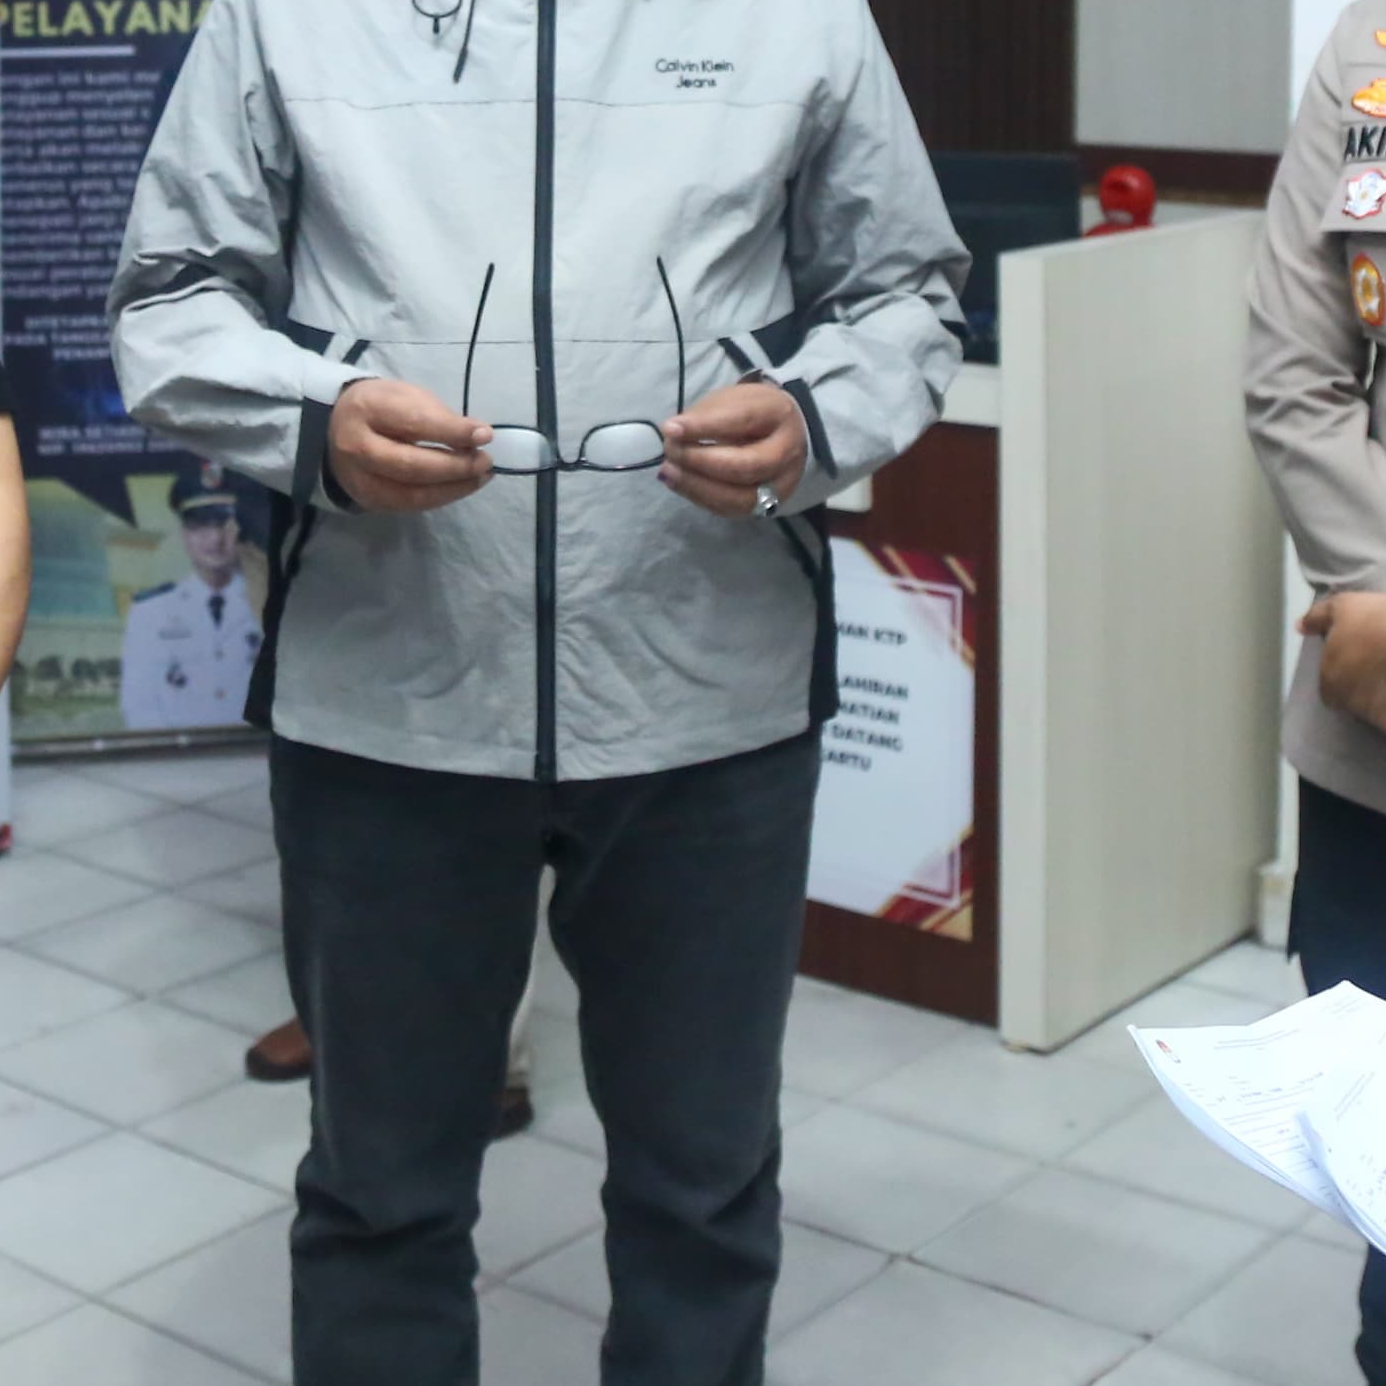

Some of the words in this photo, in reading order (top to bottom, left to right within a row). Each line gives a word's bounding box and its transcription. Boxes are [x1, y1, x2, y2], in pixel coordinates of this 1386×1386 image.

[655, 58, 699, 73] Calvin
[701, 59, 734, 72] Klein
[676, 75, 717, 89] Jeans
[874, 628, 908, 646] KTP
[831, 724, 904, 752] DATANG
